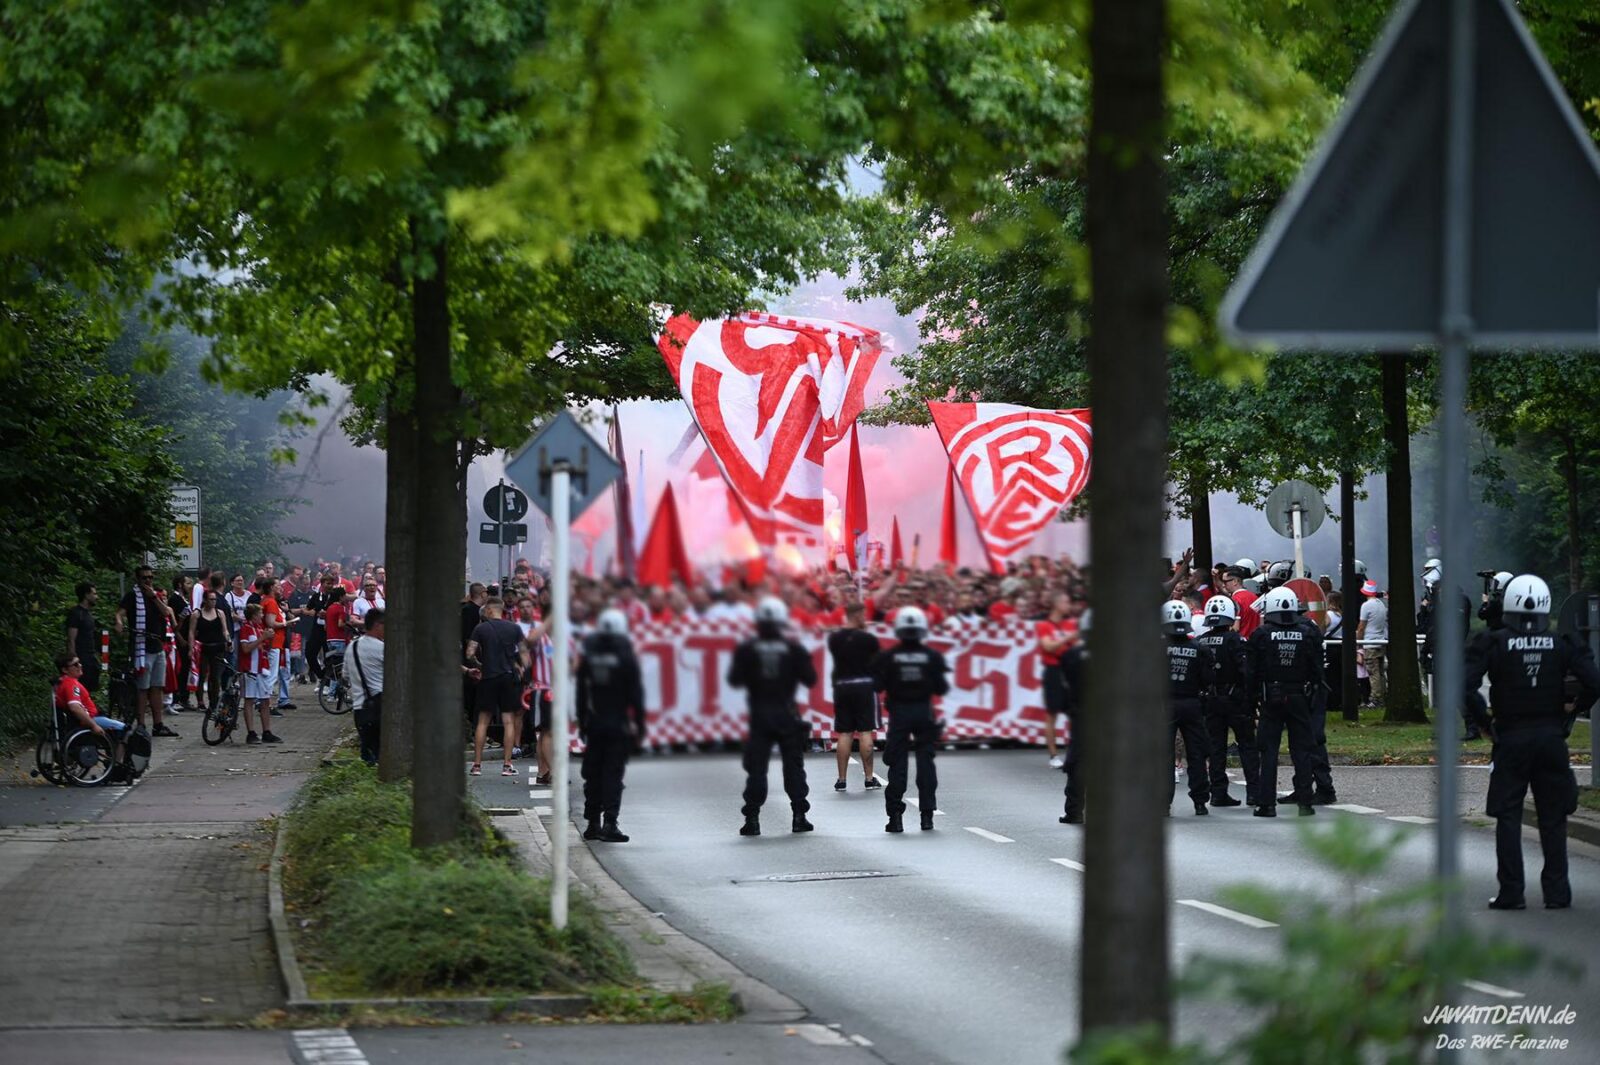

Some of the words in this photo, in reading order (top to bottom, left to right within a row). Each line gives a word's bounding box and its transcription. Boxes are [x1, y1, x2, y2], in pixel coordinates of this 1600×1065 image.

[171, 496, 197, 504] adweg
[1271, 631, 1303, 641] POLIZEI
[1278, 643, 1297, 651] NRW
[1507, 636, 1554, 651] POLIZEI
[1167, 646, 1198, 658] POLIZEI
[1527, 665, 1541, 676] 27
